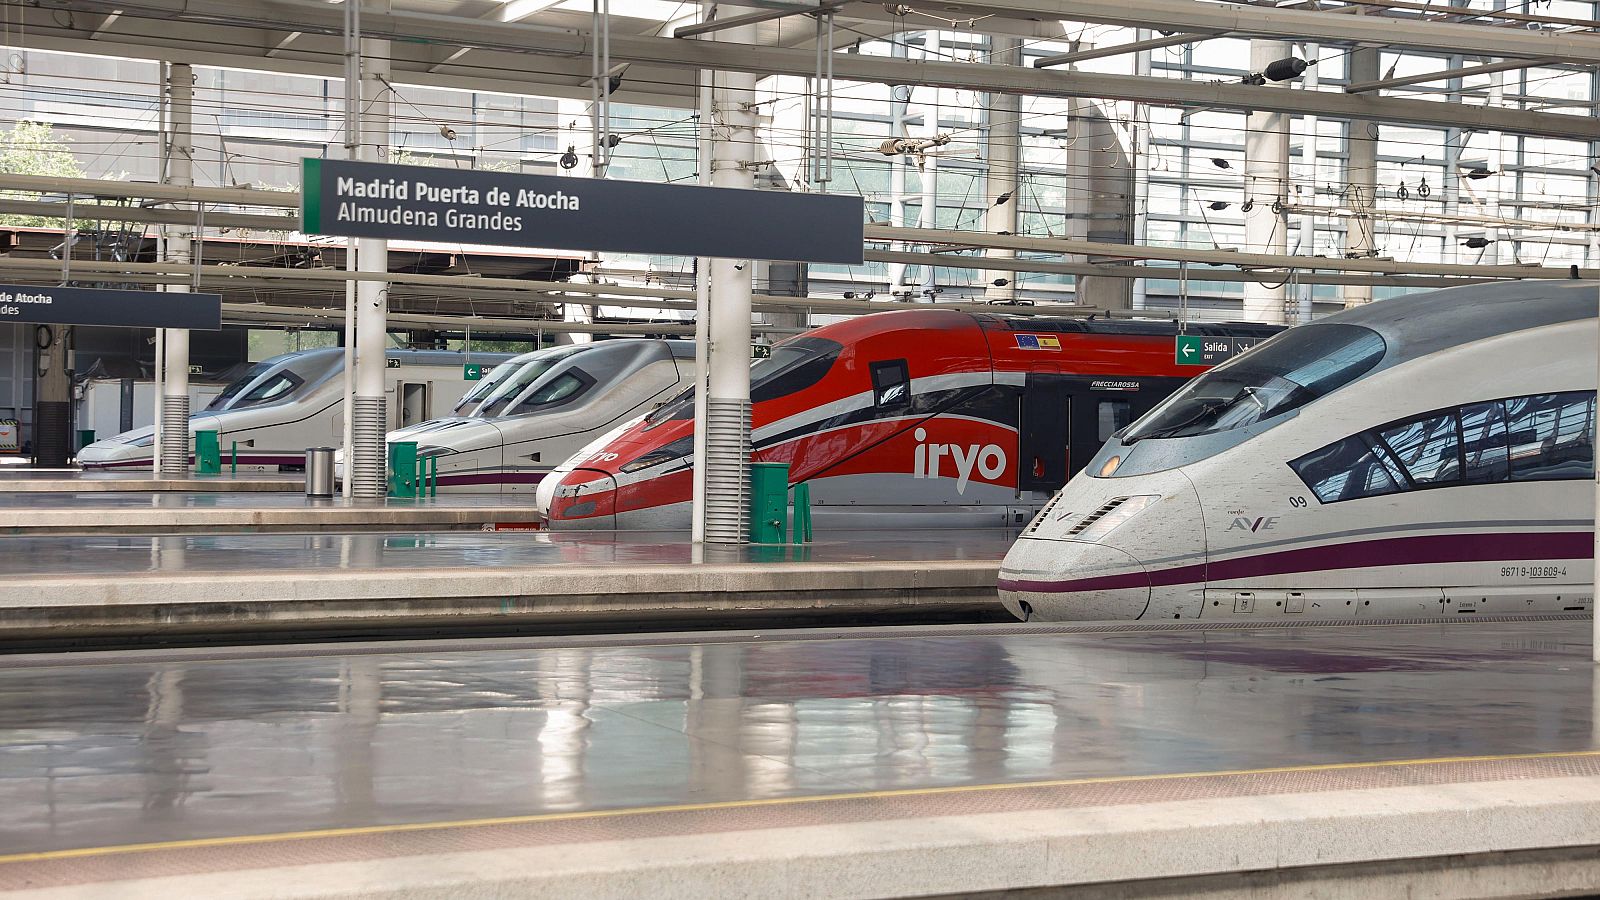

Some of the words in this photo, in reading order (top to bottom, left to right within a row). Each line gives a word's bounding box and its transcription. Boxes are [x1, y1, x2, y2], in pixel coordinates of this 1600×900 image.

[337, 177, 408, 200] Madrid
[416, 182, 479, 205] Puerta
[486, 187, 511, 206] de
[516, 189, 580, 211] Atocha
[337, 202, 438, 227] Almudena
[445, 209, 522, 232] Grandes
[0, 292, 13, 302] de
[15, 293, 53, 304] Atocha
[0, 305, 20, 315] des
[1204, 342, 1228, 352] Salida
[914, 427, 1007, 496] iryo
[1289, 496, 1307, 508] 09
[1226, 516, 1281, 533] AVE
[1501, 567, 1519, 577] 9671
